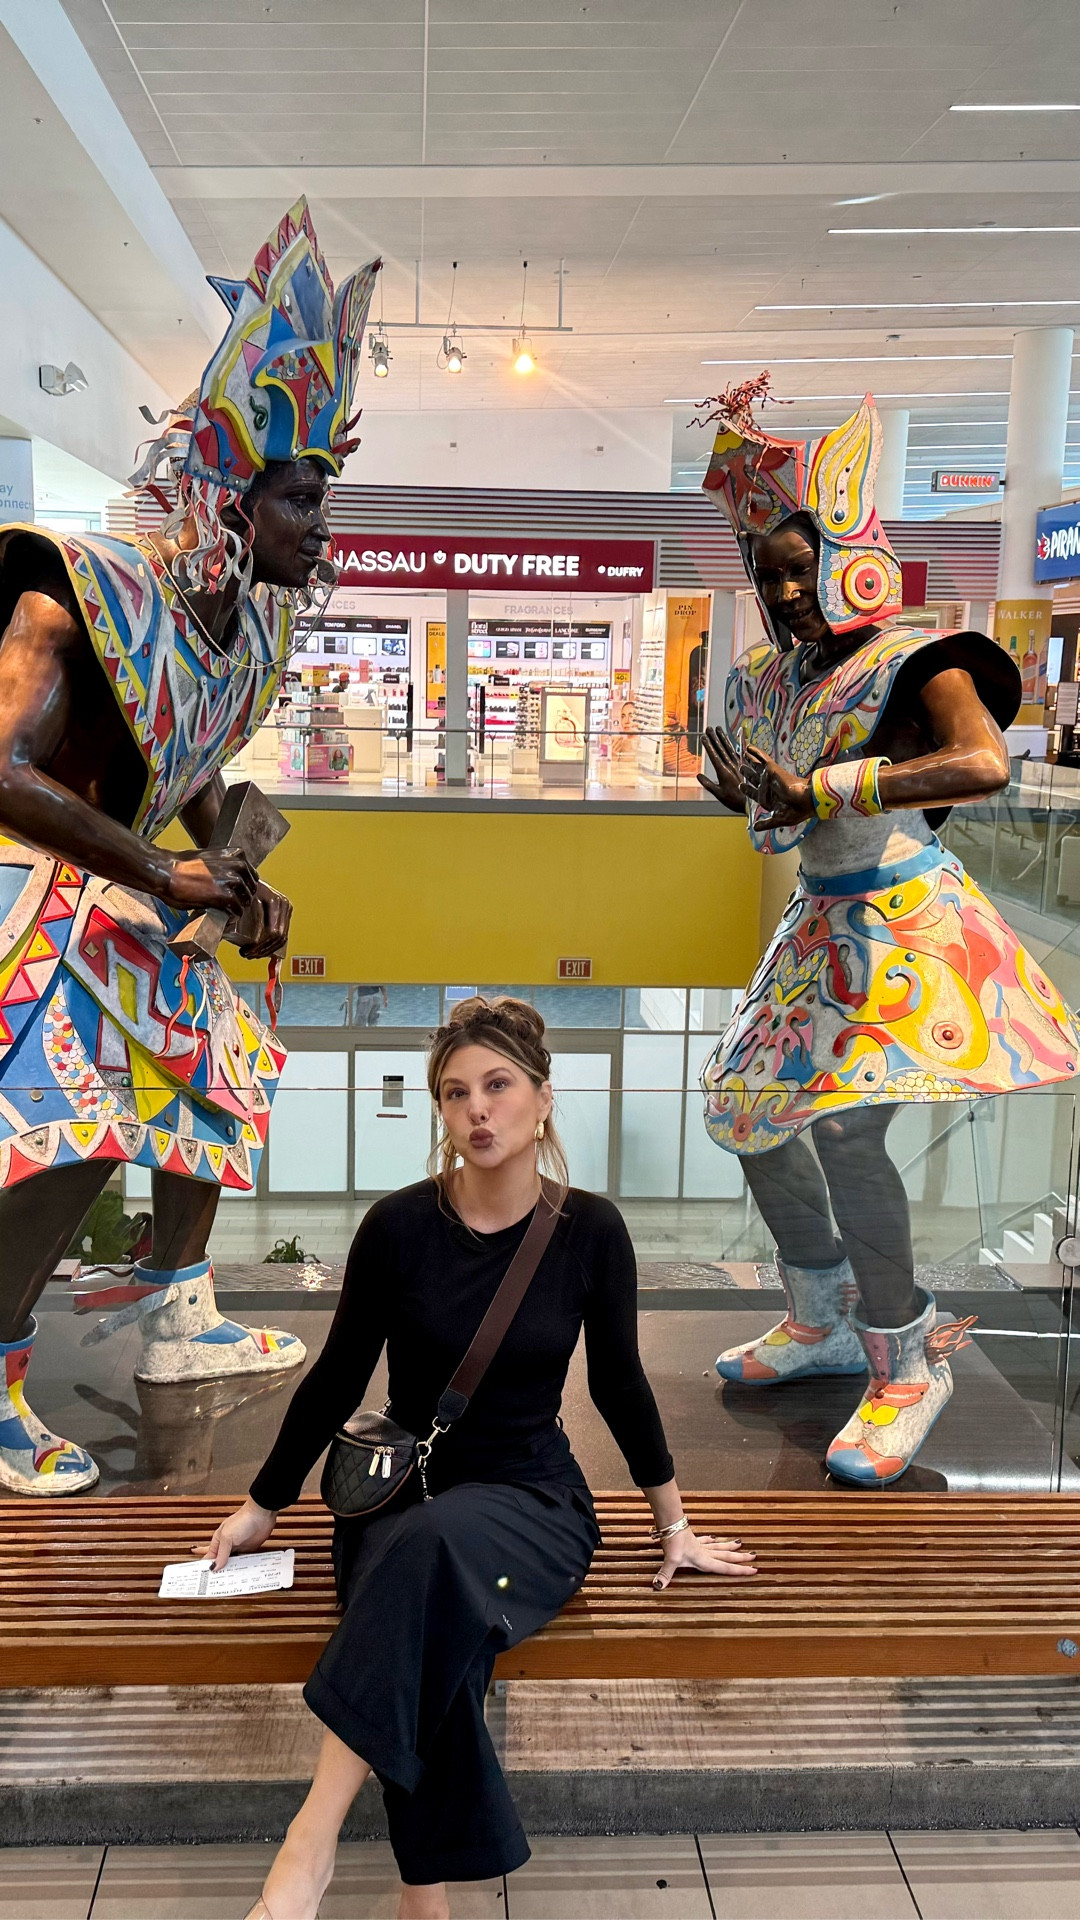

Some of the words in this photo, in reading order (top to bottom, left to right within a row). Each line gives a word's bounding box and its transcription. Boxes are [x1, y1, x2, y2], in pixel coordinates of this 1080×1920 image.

[940, 474, 996, 488] DUNKIN'
[454, 554, 517, 574] DUTY
[522, 555, 580, 577] FREE
[607, 566, 645, 577] DUFRY
[504, 605, 573, 615] FRAGRANCES
[998, 609, 1043, 619] WALKER
[298, 958, 319, 975] EXIT
[565, 961, 586, 976] EXIT
